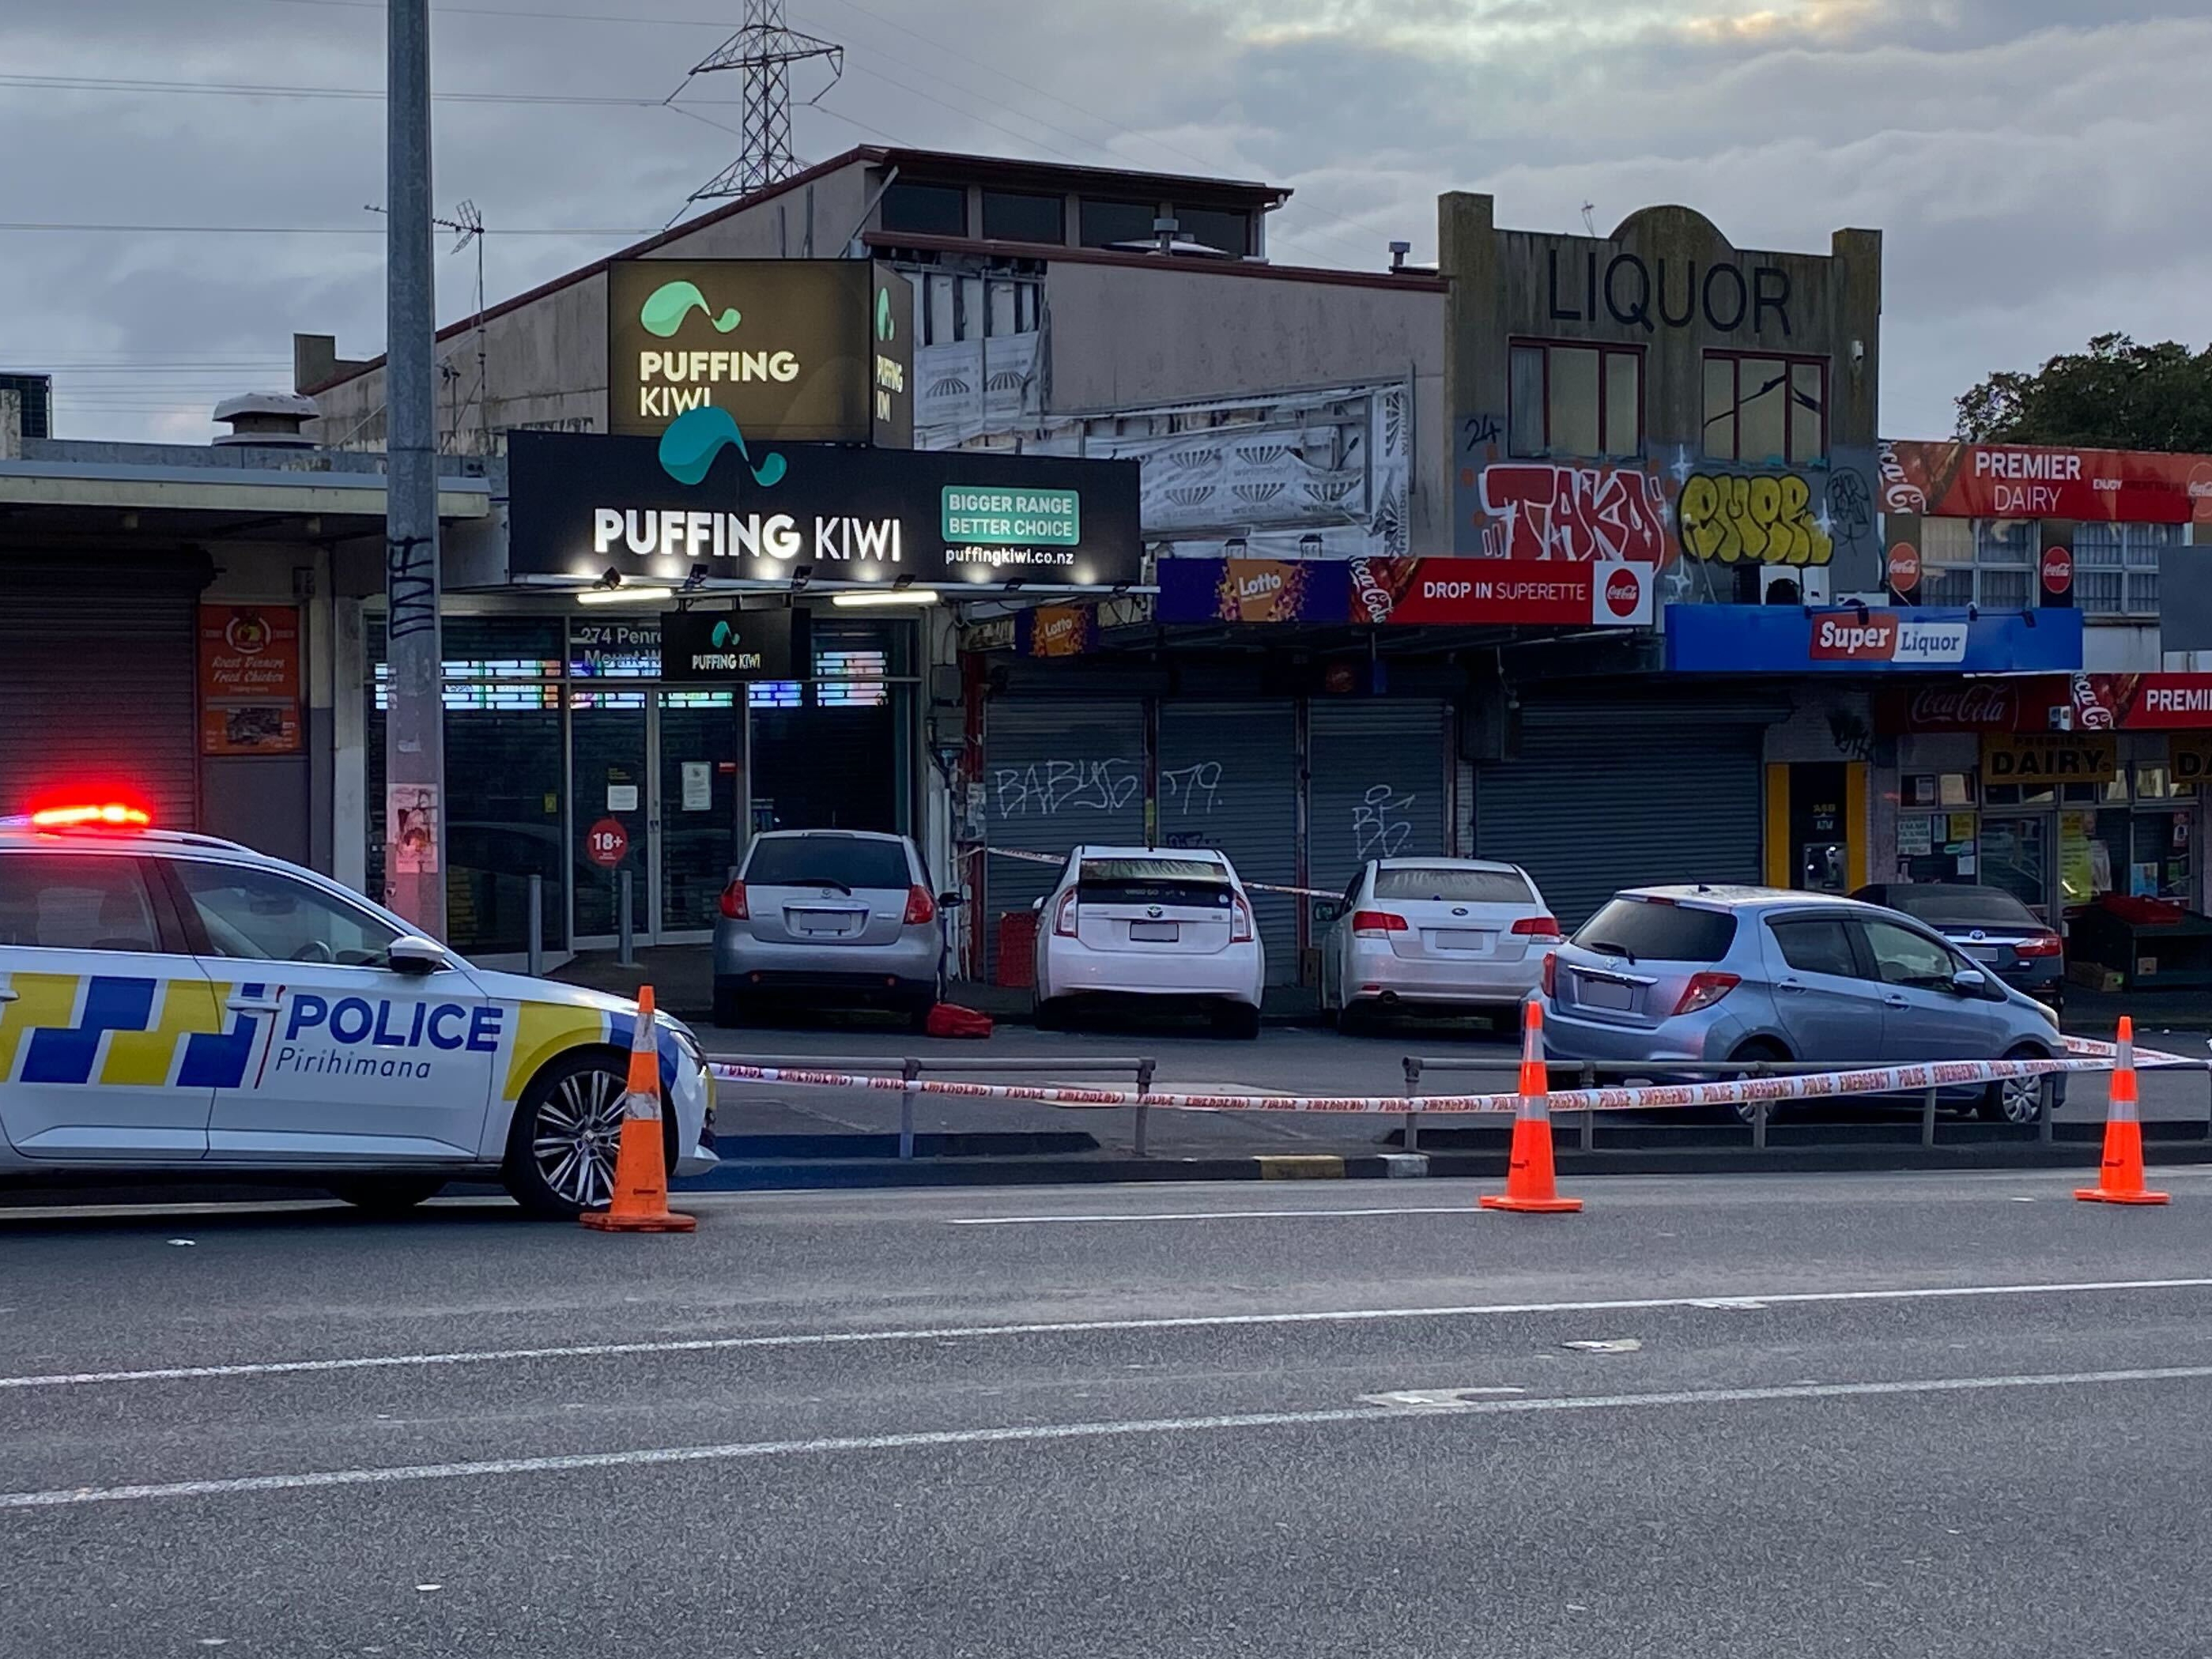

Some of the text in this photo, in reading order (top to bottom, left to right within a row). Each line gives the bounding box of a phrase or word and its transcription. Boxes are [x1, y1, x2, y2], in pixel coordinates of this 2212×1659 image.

[1549, 249, 1791, 335] LIQUOR
[640, 351, 799, 383] PUFFING
[640, 387, 712, 418] KIWI
[1976, 452, 2081, 481] PREMIER
[949, 493, 1073, 515] BIGGER RANGE
[1994, 485, 2062, 513] DAIRY
[594, 508, 901, 562] PUFFING KIWI
[949, 517, 1073, 537] BETTER CHOICE
[946, 547, 1074, 567] puffingkiwi.co.nz
[1238, 571, 1282, 597] Lotto
[1424, 581, 1586, 601] DROP IN SUPERETTE
[582, 628, 611, 644] 274
[1820, 621, 1960, 657] Super Liquor
[584, 650, 640, 668] Mount
[692, 653, 761, 670] PUFFING KIWI
[1912, 683, 2006, 723] Coca-Cola
[2146, 689, 2212, 711] PREMI
[1991, 750, 2104, 775] DAIRY
[593, 832, 623, 850] 18+
[285, 994, 504, 1052] POLICE
[276, 1046, 431, 1080] Pirihimana
